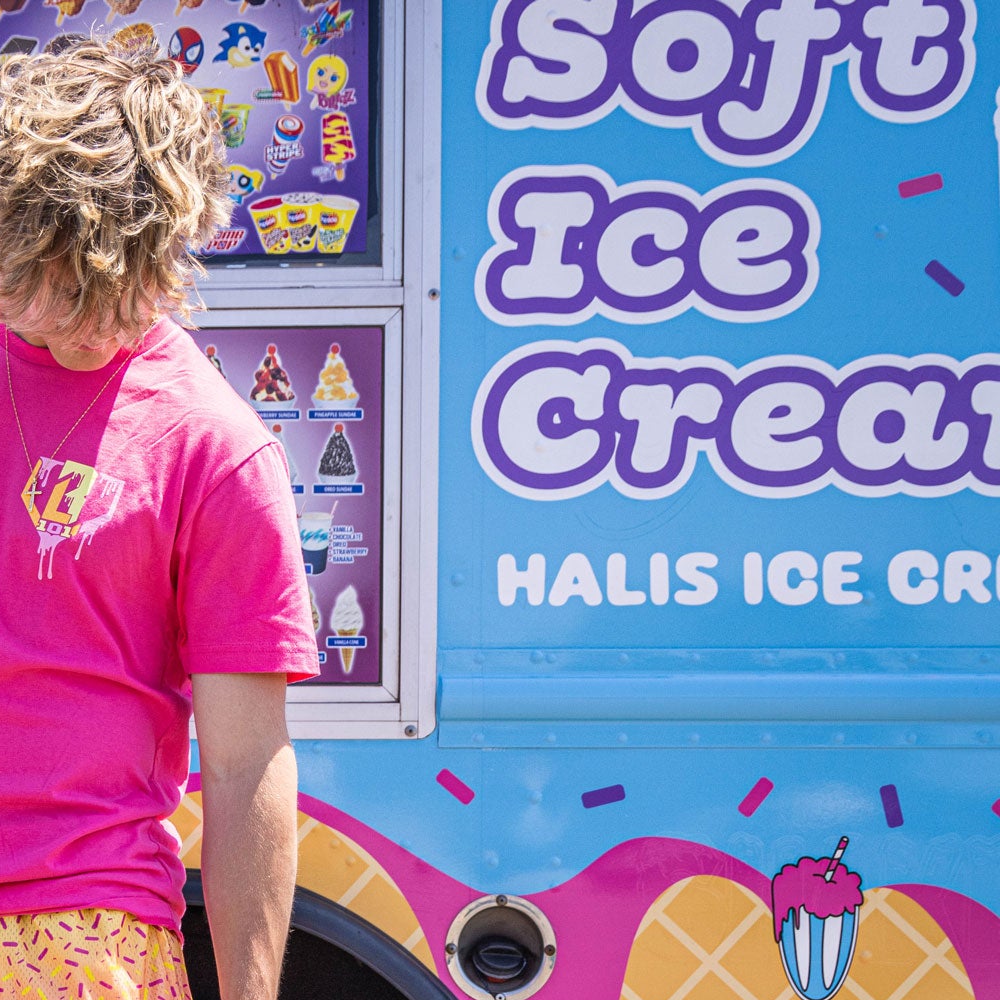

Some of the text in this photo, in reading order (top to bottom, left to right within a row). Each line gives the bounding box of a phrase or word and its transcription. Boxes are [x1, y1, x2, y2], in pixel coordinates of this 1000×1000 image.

[485, 0, 968, 156] Soft
[206, 240, 238, 250] POP
[486, 176, 810, 315] Ice
[497, 550, 1000, 607] HALIS ICE CR
